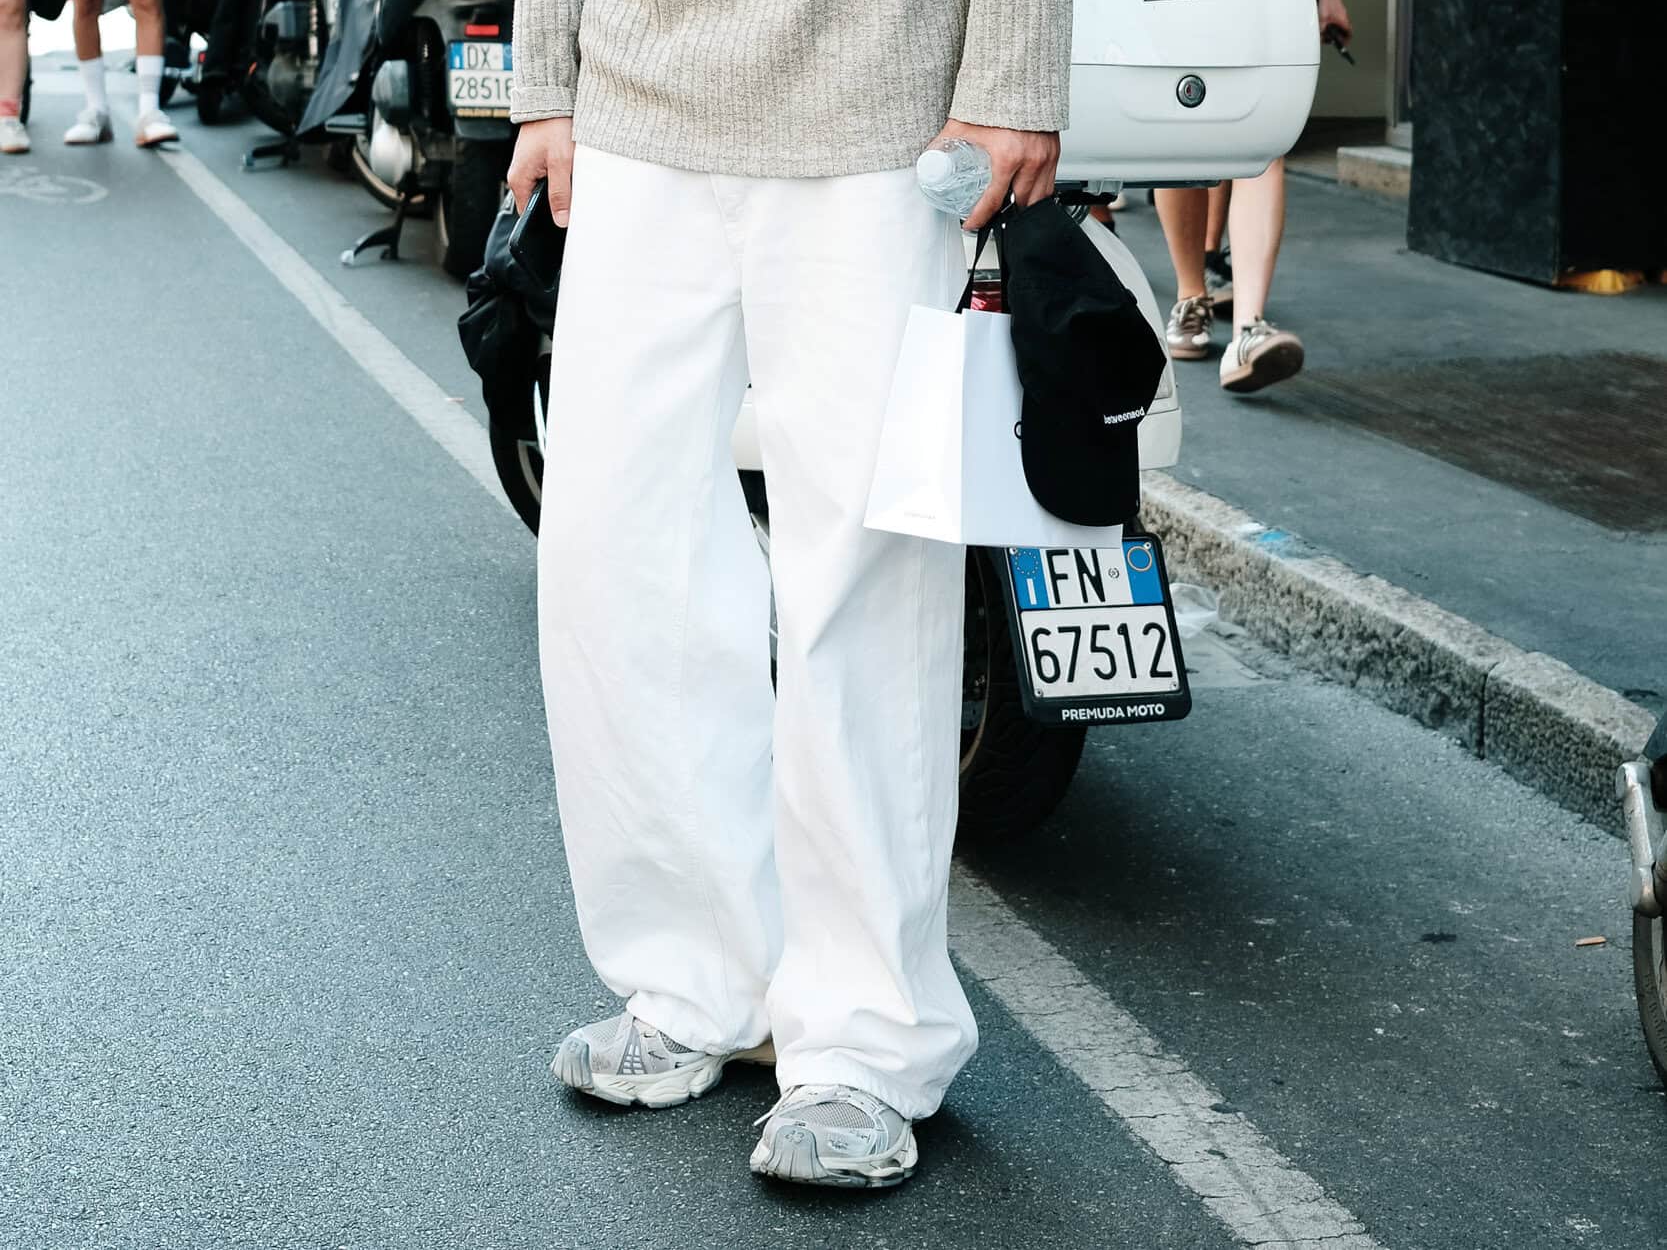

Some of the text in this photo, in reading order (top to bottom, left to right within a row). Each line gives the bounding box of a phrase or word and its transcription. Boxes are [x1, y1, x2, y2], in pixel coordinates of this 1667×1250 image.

[467, 44, 492, 70] DX
[1045, 549, 1106, 605] FN
[1031, 622, 1174, 684] 67512
[1061, 703, 1166, 721] PREMUDA MOTO
